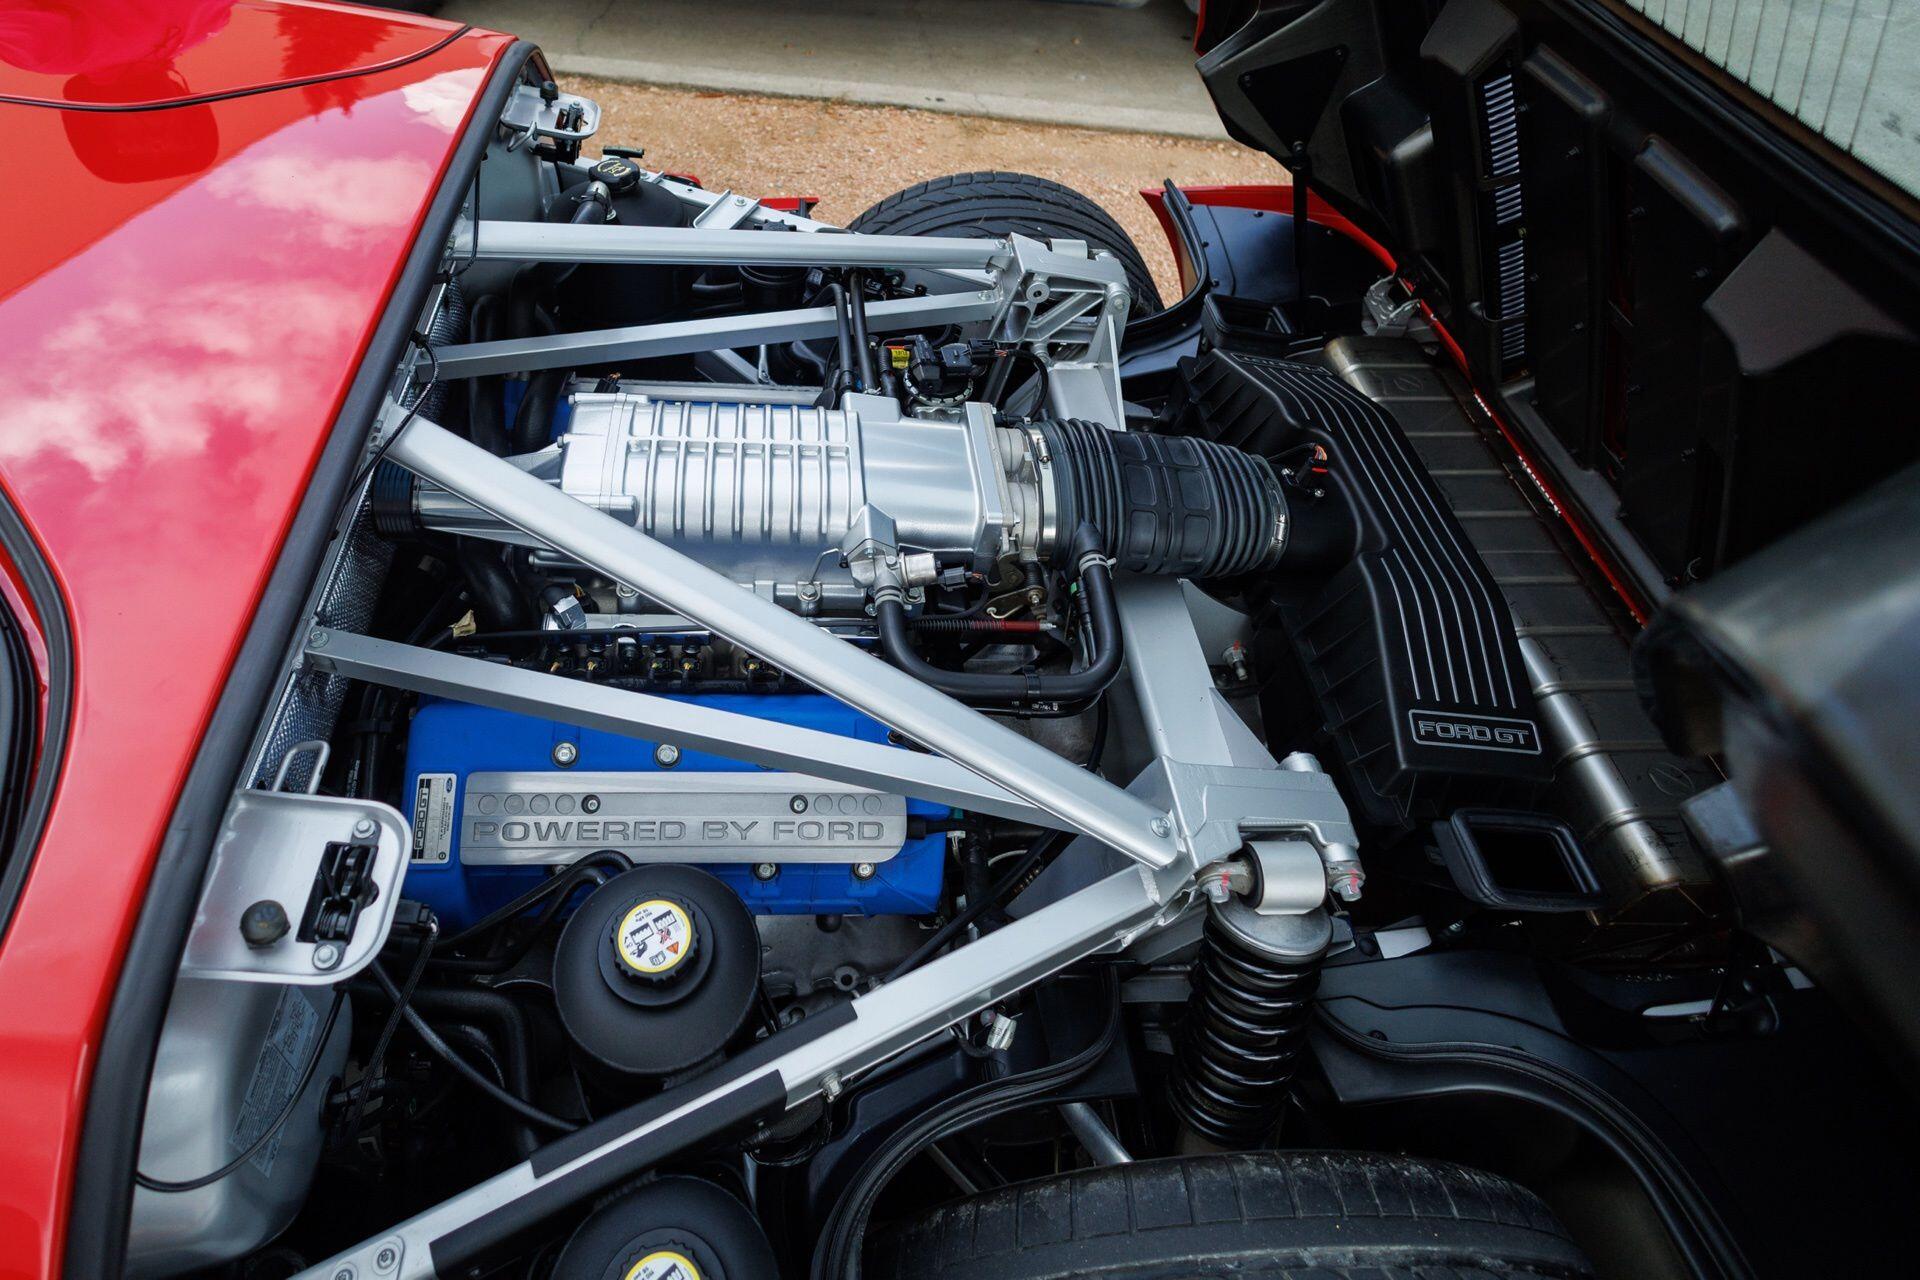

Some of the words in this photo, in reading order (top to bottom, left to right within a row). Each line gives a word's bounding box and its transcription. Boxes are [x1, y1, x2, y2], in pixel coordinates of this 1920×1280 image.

[1418, 720, 1491, 741] FORD
[1494, 727, 1529, 745] GT
[420, 789, 428, 808] GT
[415, 810, 426, 849] FORD
[472, 821, 687, 842] POWERED
[702, 821, 759, 841] BY
[773, 821, 884, 841] FORD
